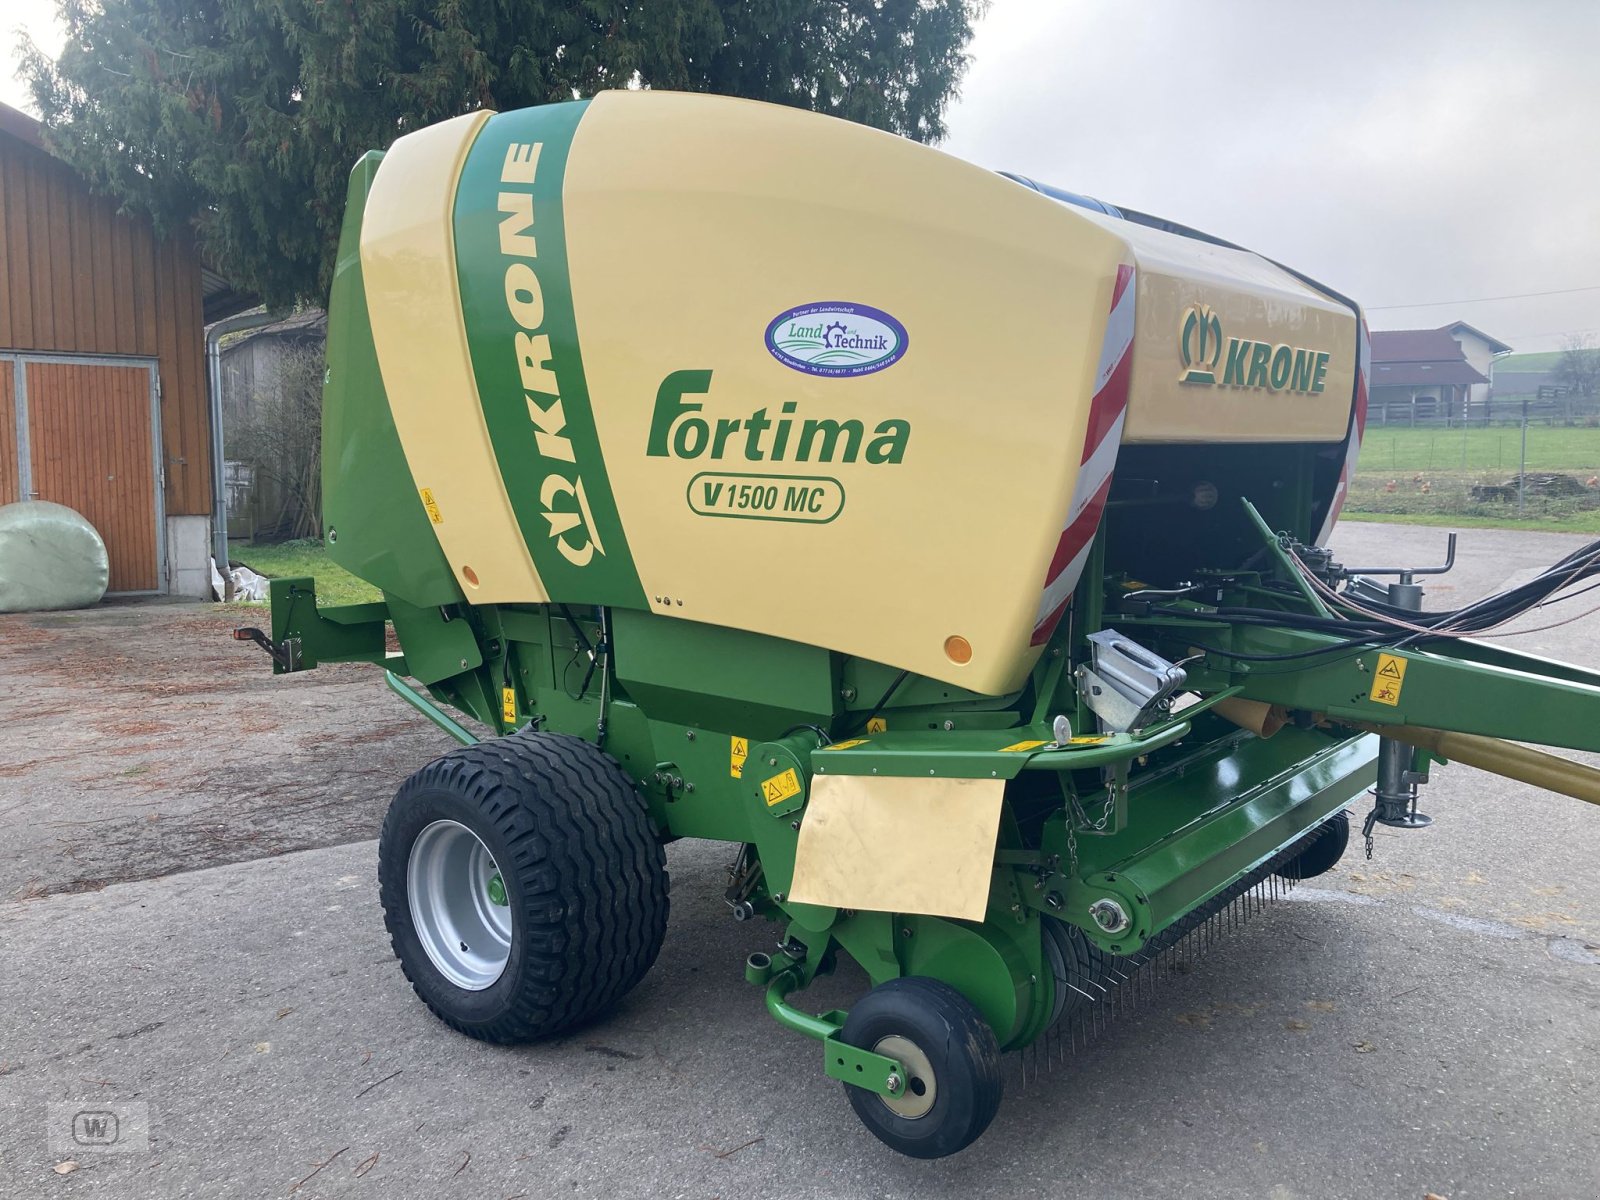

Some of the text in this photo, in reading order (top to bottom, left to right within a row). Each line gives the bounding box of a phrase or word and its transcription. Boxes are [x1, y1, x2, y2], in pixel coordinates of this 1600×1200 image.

[497, 142, 576, 463] KRONE
[792, 309, 809, 318] Partner
[819, 306, 855, 314] Landwirtschaft
[788, 323, 823, 339] Land
[834, 334, 888, 350] Technik
[1223, 337, 1330, 393] KRONE
[646, 369, 911, 465] Fortima
[704, 482, 825, 513] V 1500 MC
